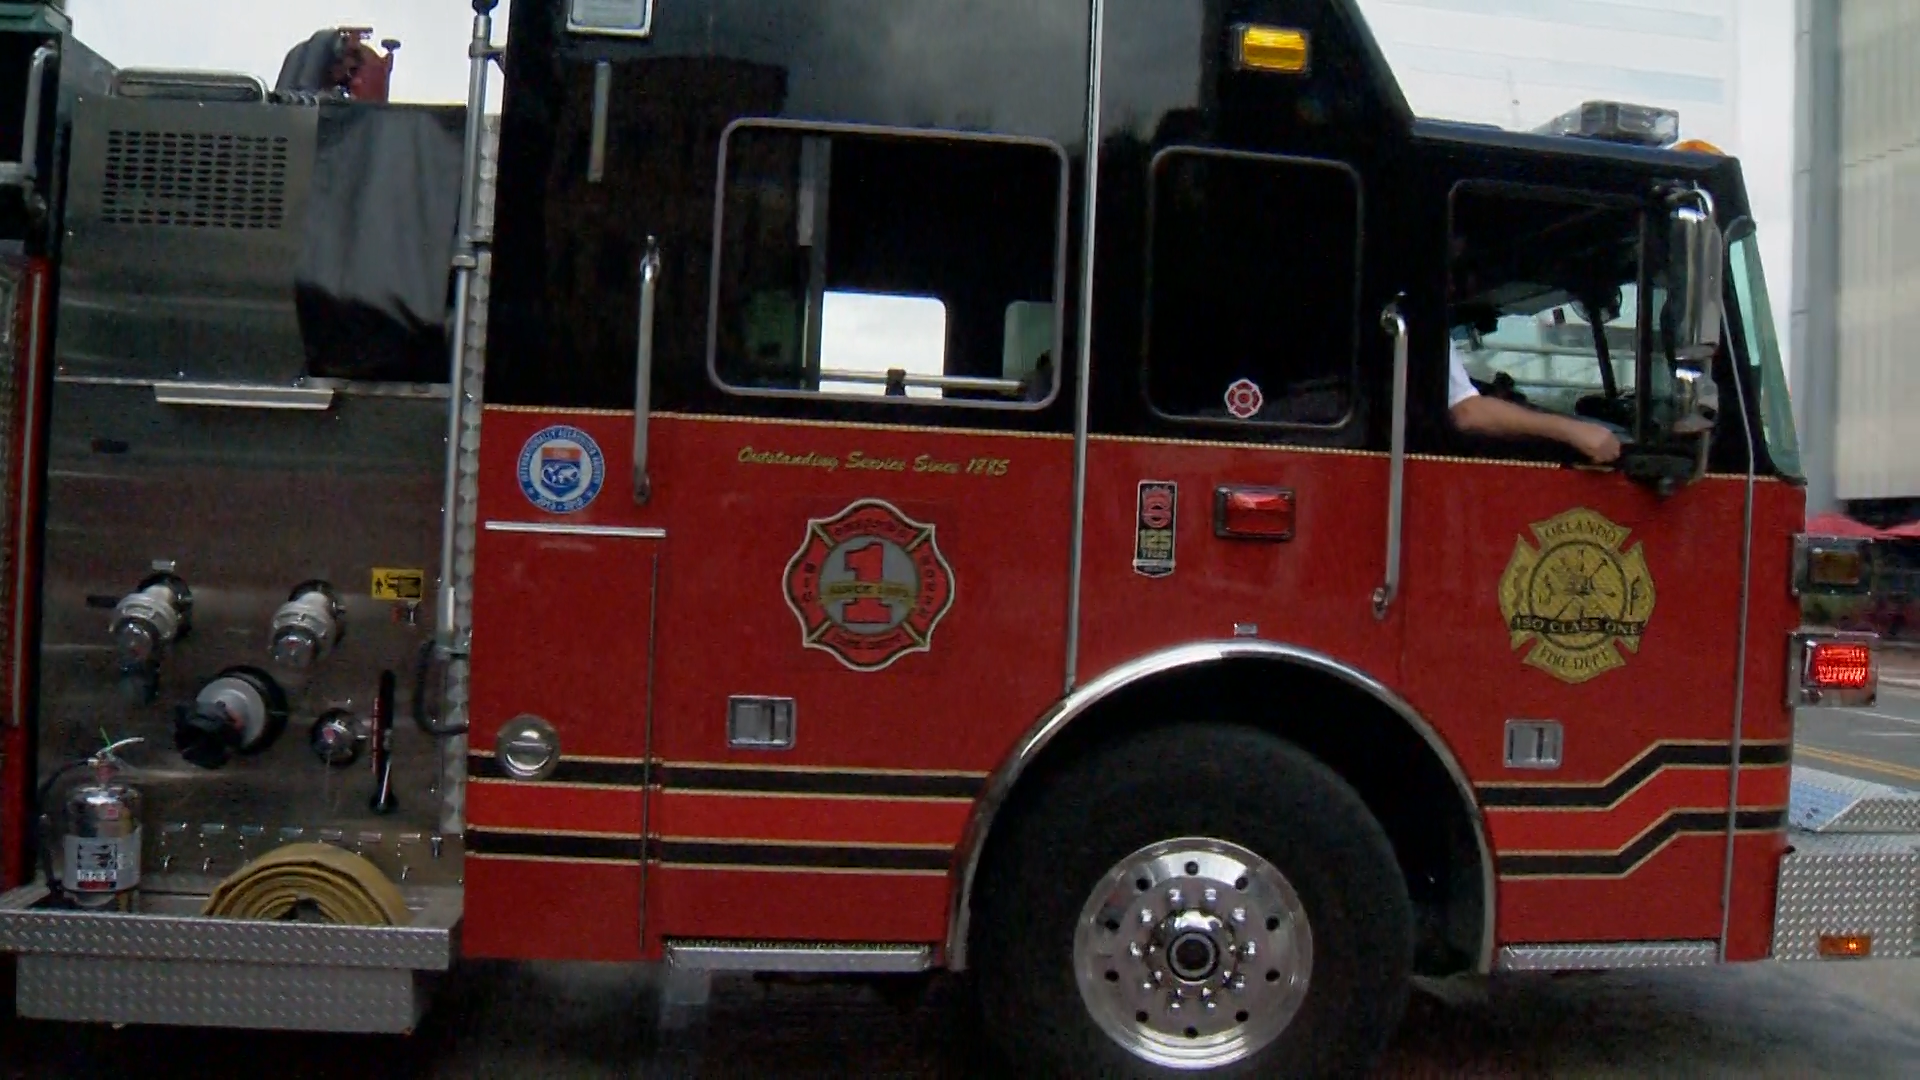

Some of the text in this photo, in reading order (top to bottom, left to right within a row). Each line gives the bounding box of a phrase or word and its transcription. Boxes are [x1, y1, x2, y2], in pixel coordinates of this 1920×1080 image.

[738, 446, 1010, 476] Outstanding Service Since 1885
[1545, 520, 1617, 542] ORLANDO
[842, 541, 892, 624] 1
[1549, 617, 1600, 634] CLASS
[1605, 621, 1640, 635] ONE
[1539, 646, 1567, 668] FIRE
